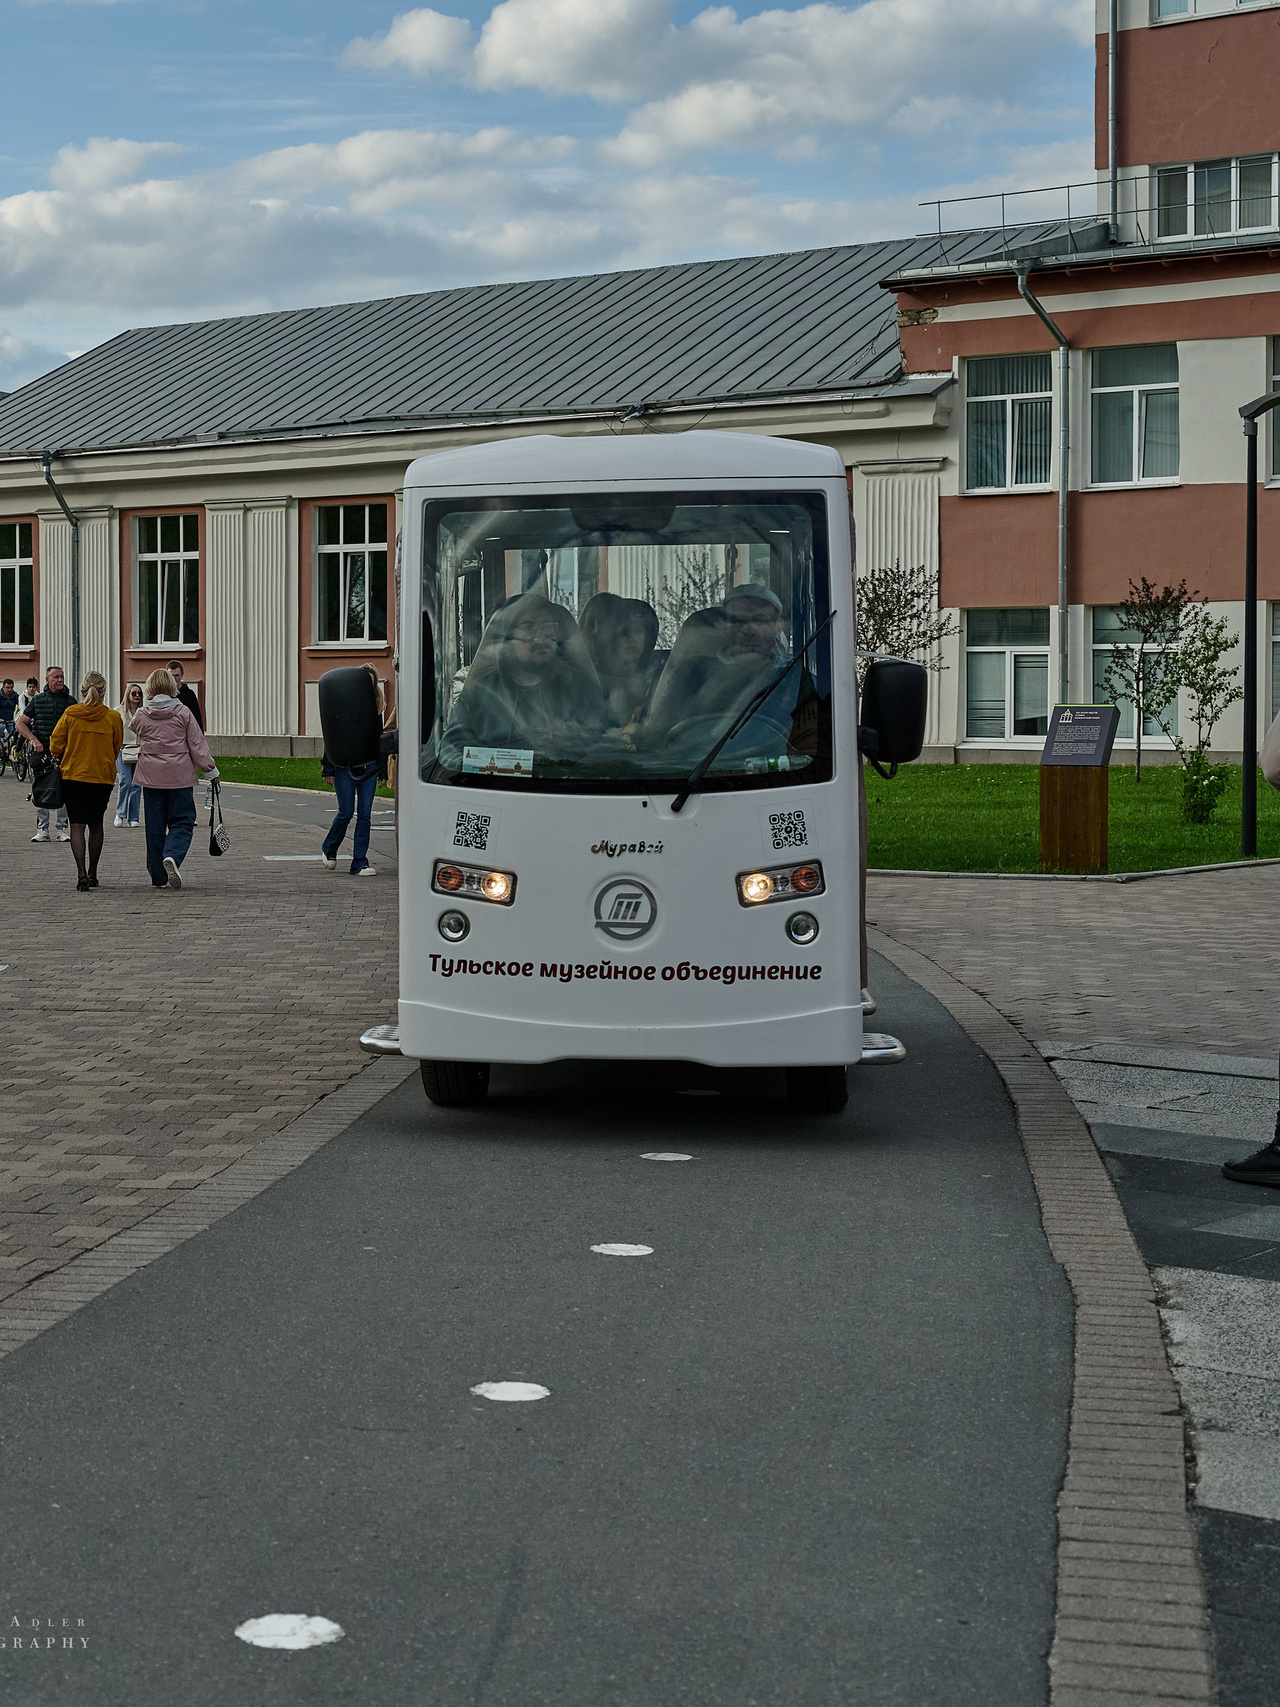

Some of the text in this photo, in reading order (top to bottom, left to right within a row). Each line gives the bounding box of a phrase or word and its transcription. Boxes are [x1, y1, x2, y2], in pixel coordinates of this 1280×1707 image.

[428, 953, 822, 985] Тульское музейное объединение
